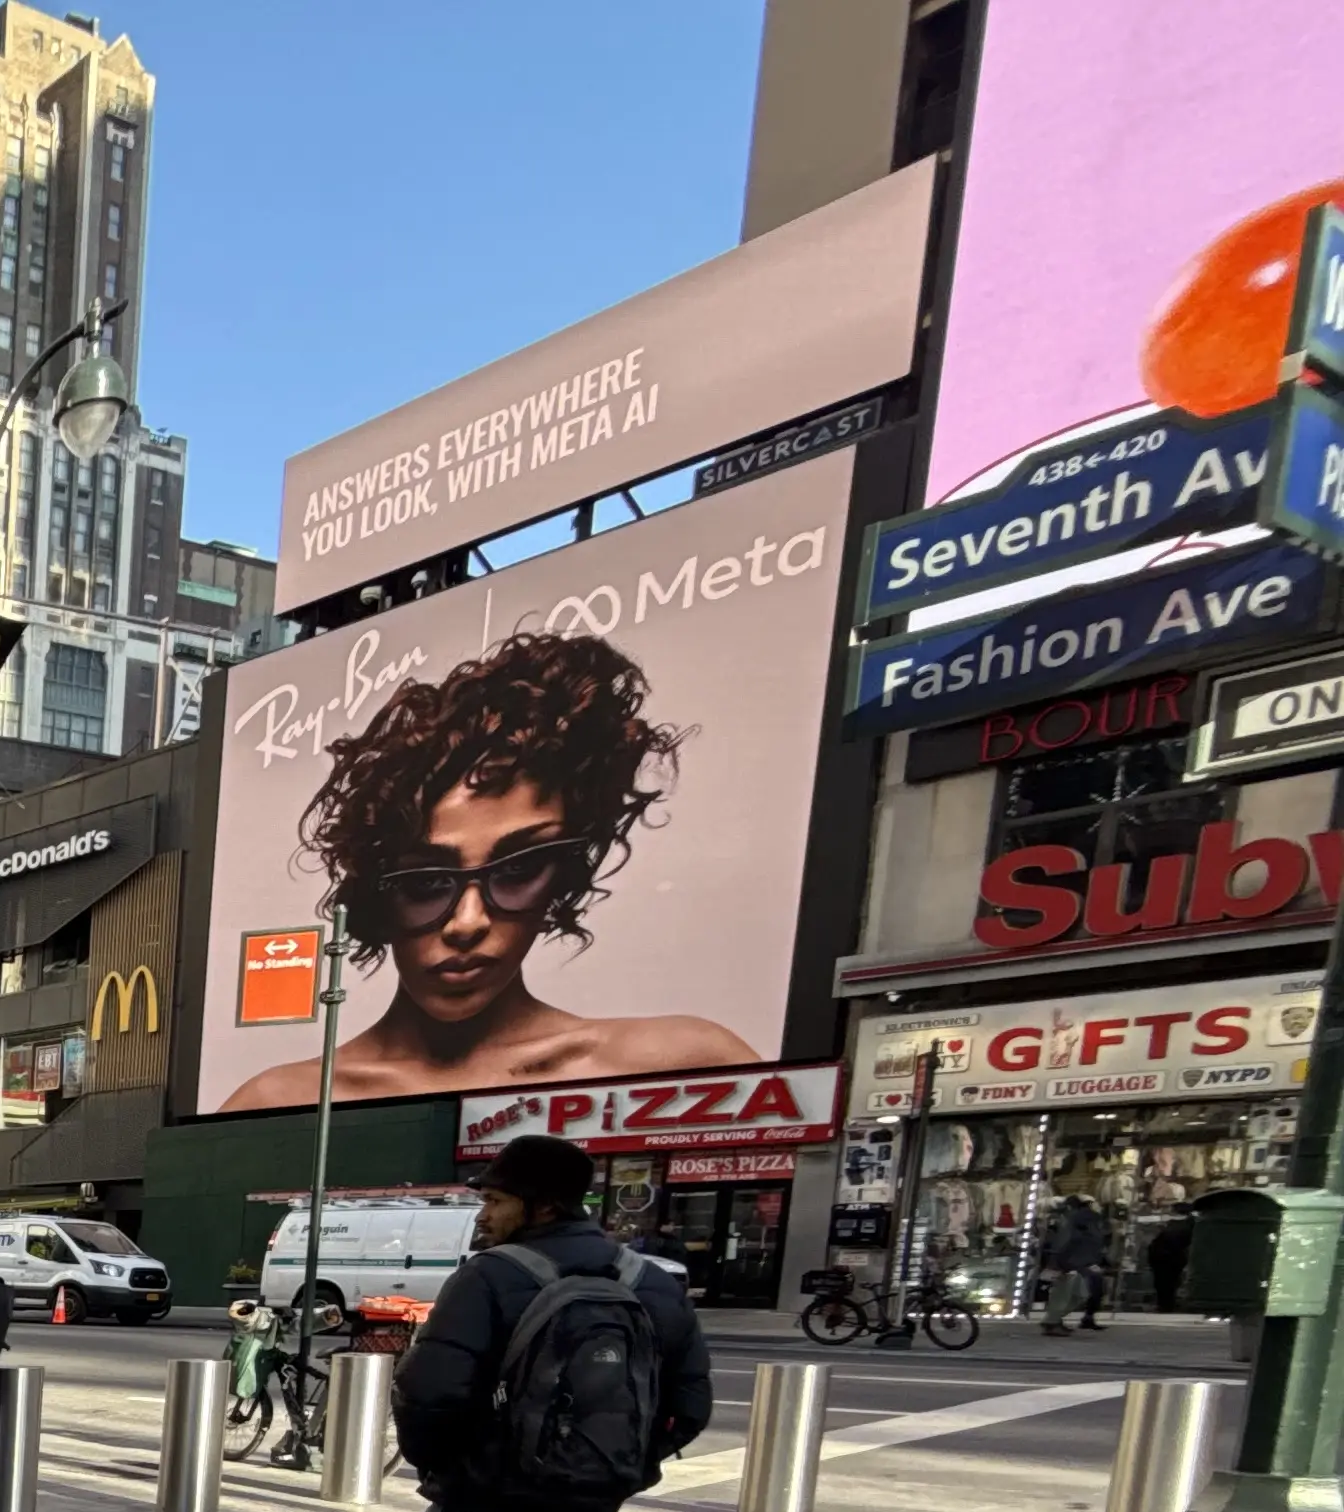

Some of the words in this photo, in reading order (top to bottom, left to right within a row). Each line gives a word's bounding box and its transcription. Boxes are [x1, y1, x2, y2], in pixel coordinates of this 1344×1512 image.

[303, 442, 431, 528] ANSWERS
[436, 348, 646, 470] EVERYWHERE
[700, 407, 873, 489] SILVERCAST
[1028, 455, 1083, 488] 438
[1108, 428, 1168, 464] 420
[301, 513, 355, 562] YOU
[358, 485, 440, 541] LOOK,
[447, 446, 524, 503] WITH
[529, 414, 615, 471] META
[621, 383, 659, 433] AI
[886, 472, 1154, 591] Seventh
[634, 524, 827, 626] Meta
[880, 616, 1123, 709] Fashion
[1145, 574, 1294, 645] Ave
[265, 956, 313, 969] Standing
[885, 1016, 970, 1032] ELECTRONICS
[1054, 1074, 1157, 1096] LUGGAGE
[1204, 1066, 1272, 1084] NYPD
[981, 1085, 1032, 1100] FDNY
[467, 1096, 543, 1142] ROSE'S
[645, 1133, 699, 1145] PROUDLY
[703, 1129, 756, 1142] SERVING
[669, 1156, 733, 1175] ROSE'S
[846, 1203, 870, 1211] ATM
[301, 1223, 349, 1235] Pguin
